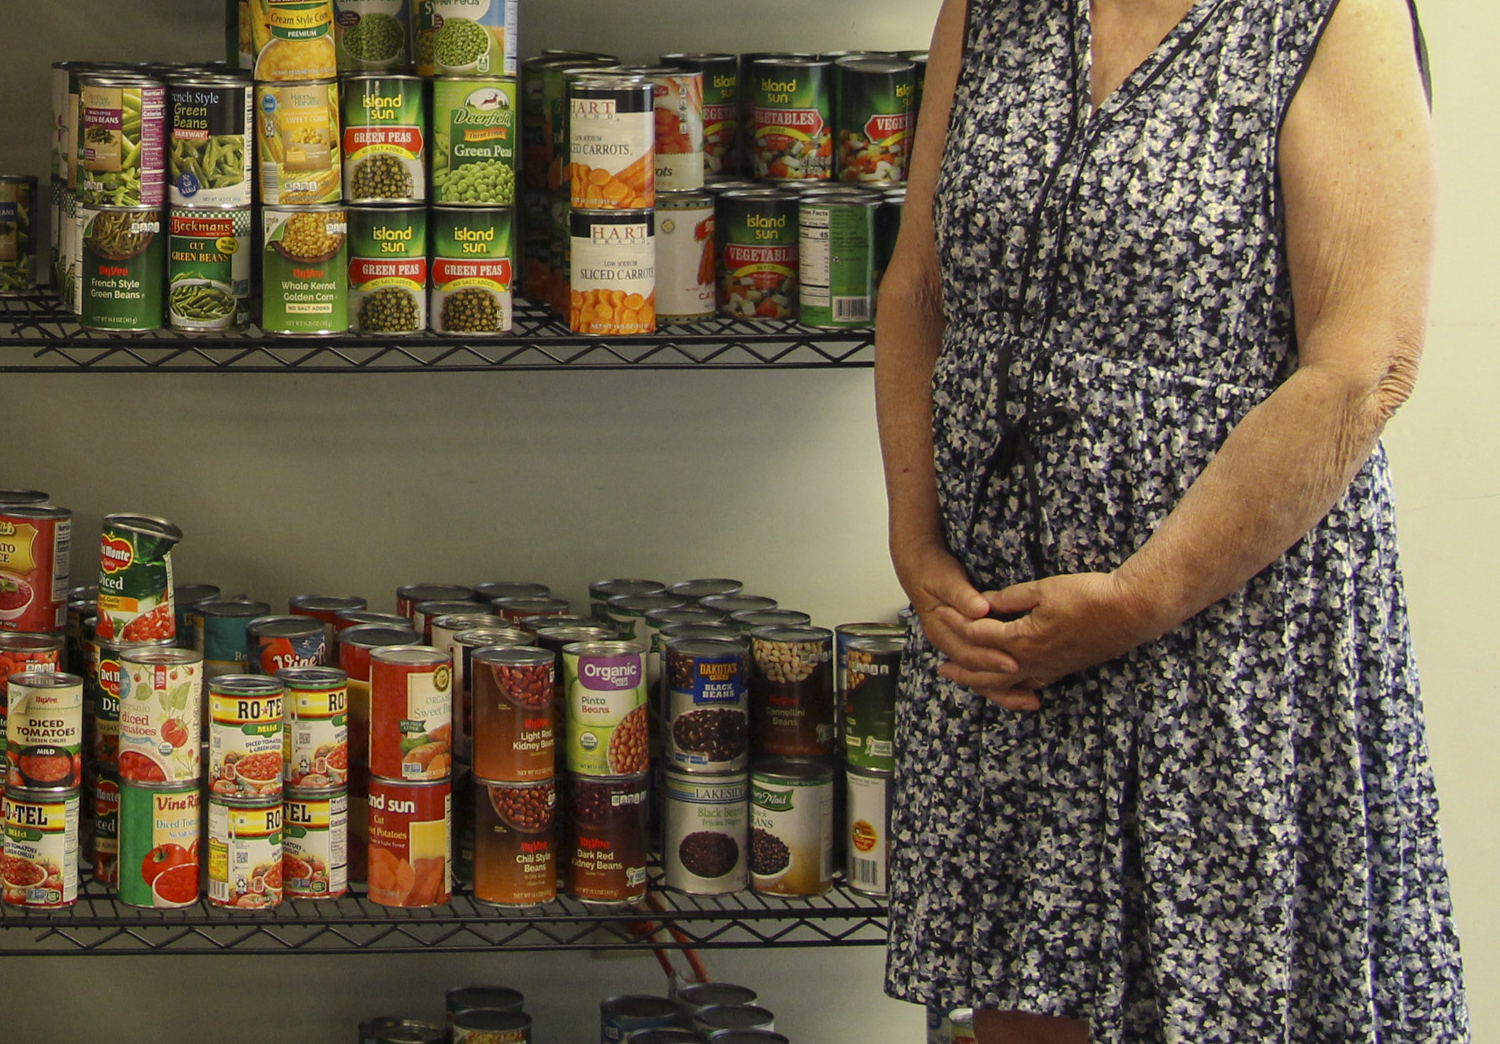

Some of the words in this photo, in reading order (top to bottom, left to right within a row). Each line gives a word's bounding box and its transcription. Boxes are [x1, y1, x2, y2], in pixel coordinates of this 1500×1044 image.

[270, 14, 290, 24] Cream
[291, 12, 312, 26] Style
[288, 29, 317, 37] PREMIUM
[362, 94, 401, 108] island
[174, 105, 207, 117] Green
[371, 108, 394, 120] sun
[454, 108, 512, 126] Deerfield
[174, 116, 207, 129] Beans
[354, 132, 385, 143] GREEN
[389, 131, 411, 143] PEAS
[454, 145, 491, 157] Green
[494, 145, 512, 157] Peas
[583, 144, 629, 156] CARROTS
[592, 226, 646, 239] HART
[581, 269, 614, 280] SLICED
[92, 278, 115, 288] French
[119, 279, 140, 289] Style
[282, 281, 308, 291] Whole
[311, 281, 336, 291] Kernel
[284, 292, 312, 301] Golden
[315, 292, 333, 301] Corn
[584, 663, 636, 681] Organic
[702, 690, 734, 698] BEANS
[582, 696, 606, 705] Pinto
[582, 706, 610, 714] Beans
[29, 719, 64, 727] DICED
[122, 713, 149, 725] diced
[16, 727, 75, 737] TOMATOES
[513, 741, 540, 752] Kidney
[157, 797, 186, 810] Vine
[388, 798, 415, 813] sun
[377, 828, 407, 840] Potatoes
